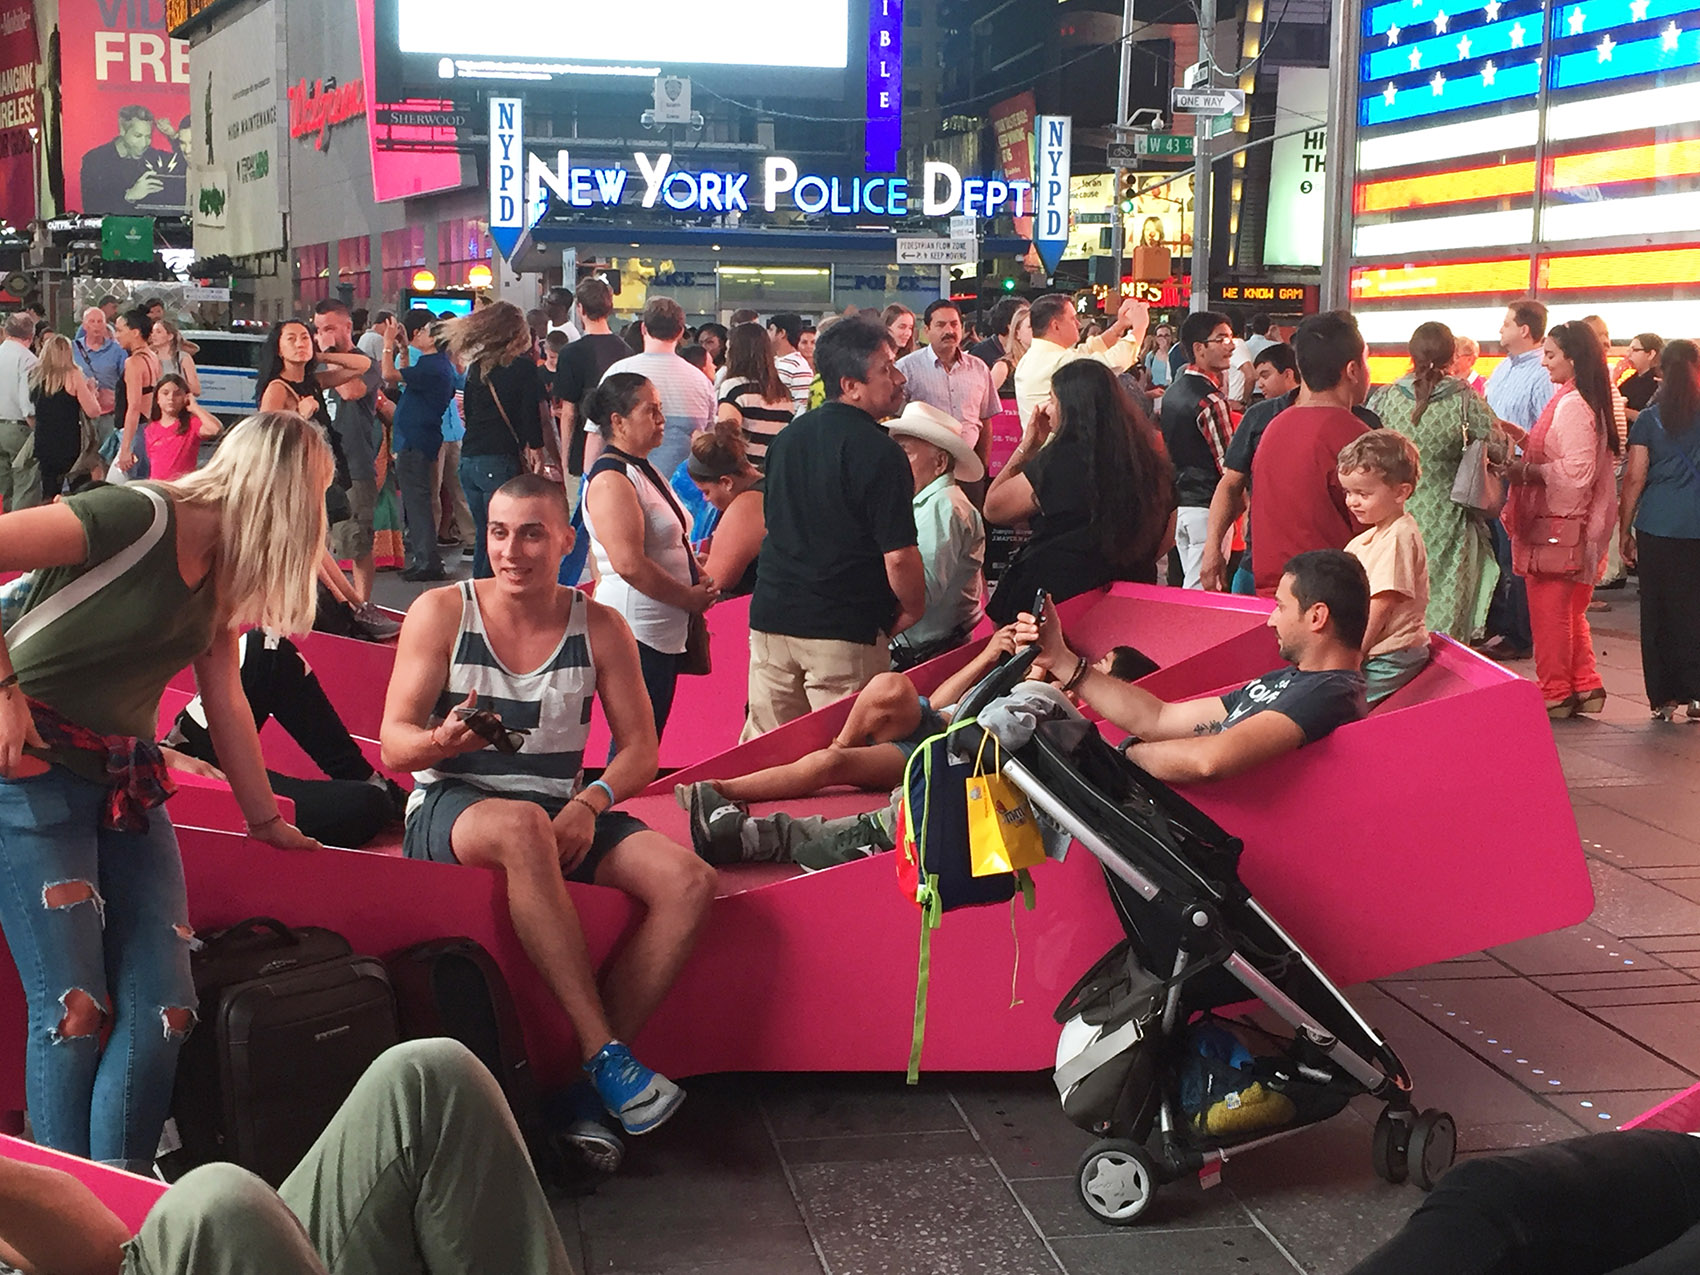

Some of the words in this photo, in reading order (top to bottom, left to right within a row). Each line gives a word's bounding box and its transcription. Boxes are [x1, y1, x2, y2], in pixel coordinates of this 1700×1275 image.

[1180, 96, 1200, 106] ONE
[1203, 96, 1224, 106] WAY
[390, 112, 466, 126] SHERWOOD
[1149, 138, 1161, 152] W
[1166, 138, 1180, 154] 43
[1304, 131, 1327, 150] HI
[498, 103, 515, 222] NYPD
[1046, 121, 1065, 236] NYPD
[900, 241, 935, 250] PEDESTRIAN
[936, 241, 951, 250] FLOW
[952, 242, 967, 250] ZONE
[930, 252, 945, 260] KEEP
[946, 252, 967, 260] MOVING
[855, 275, 919, 290] POLCE
[1223, 288, 1238, 298] WE
[1244, 288, 1274, 299] KNOW
